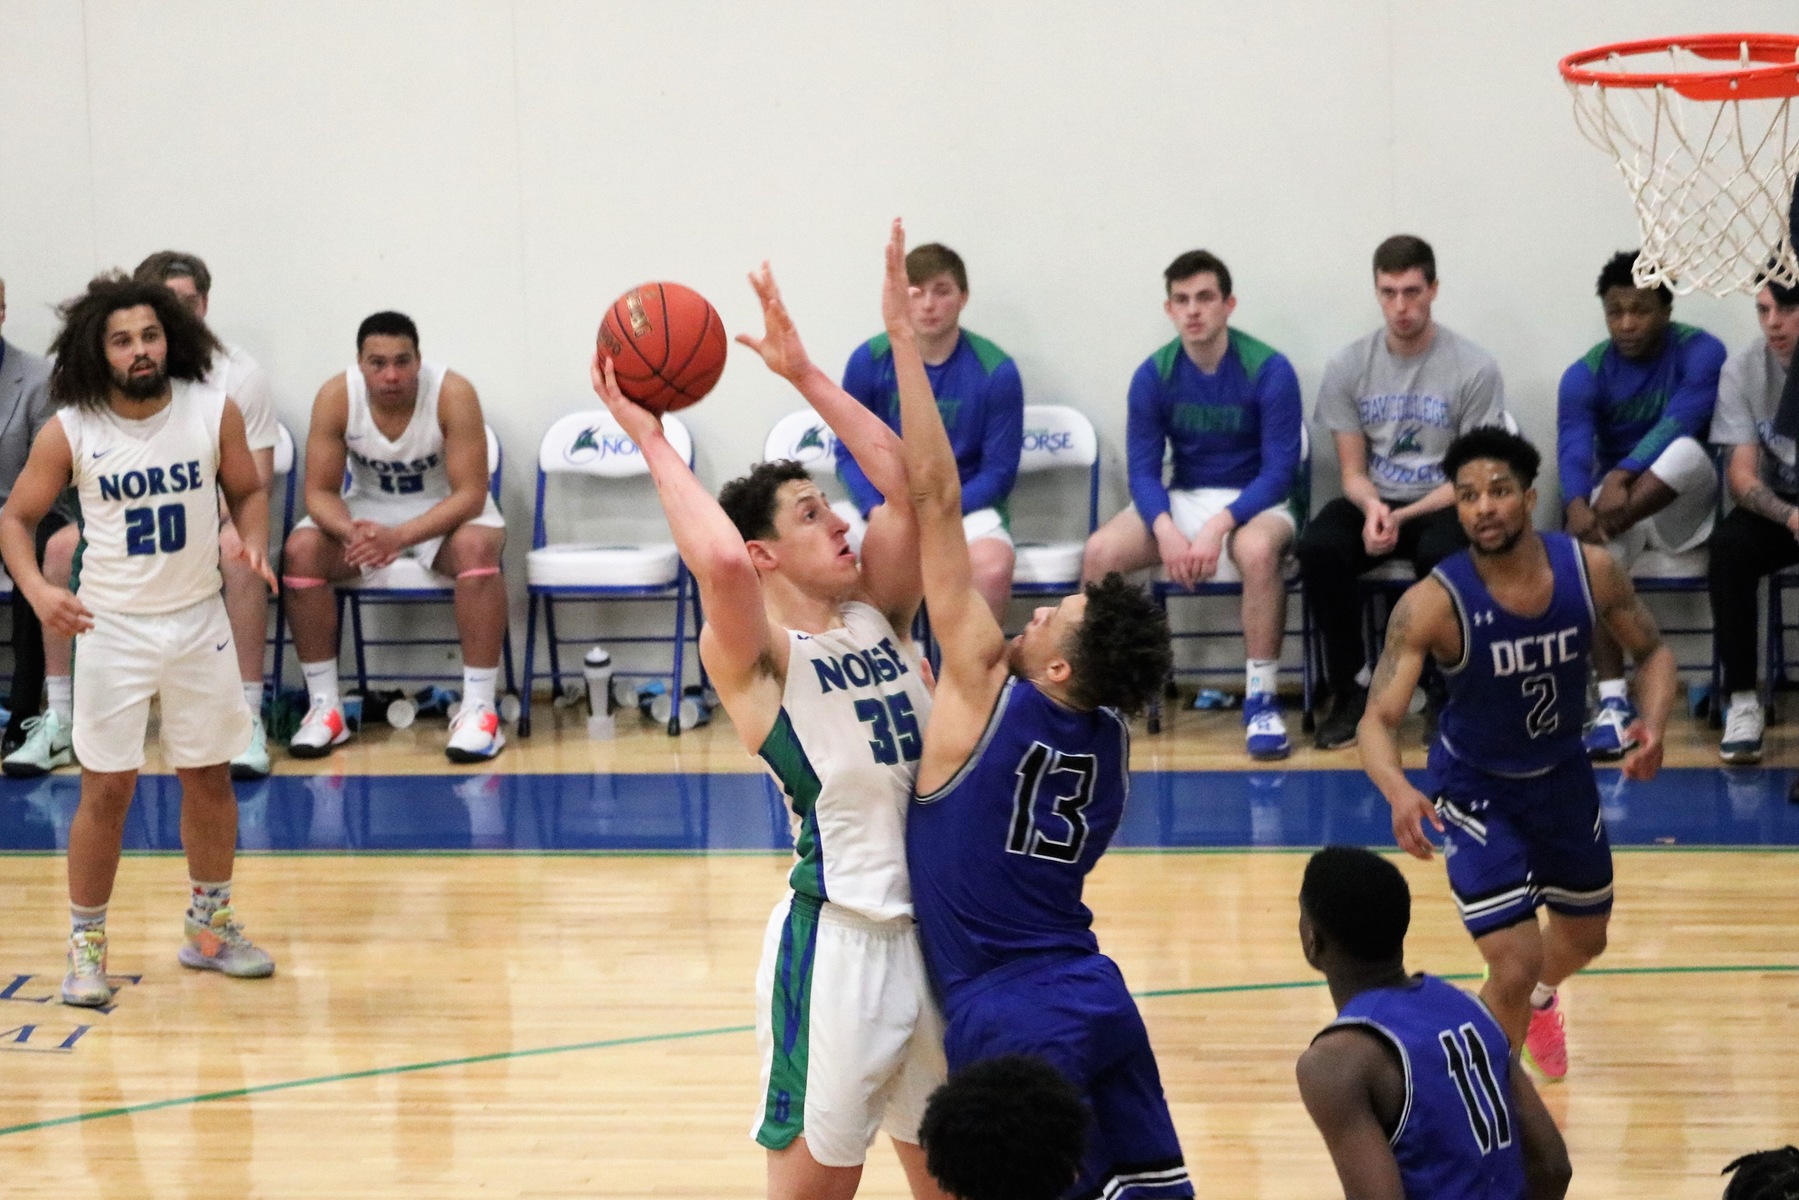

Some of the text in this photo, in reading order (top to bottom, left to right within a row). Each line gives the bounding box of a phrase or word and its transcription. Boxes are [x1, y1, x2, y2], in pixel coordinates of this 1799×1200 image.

[1022, 431, 1075, 455] ORSE
[97, 460, 203, 502] NORSE
[125, 503, 187, 557] 20
[810, 637, 909, 694] NORSE
[1490, 627, 1578, 678] DCTC
[854, 691, 922, 765] 35
[1522, 672, 1559, 740] 2
[1005, 740, 1098, 864] 13
[1439, 1021, 1512, 1157] 11
